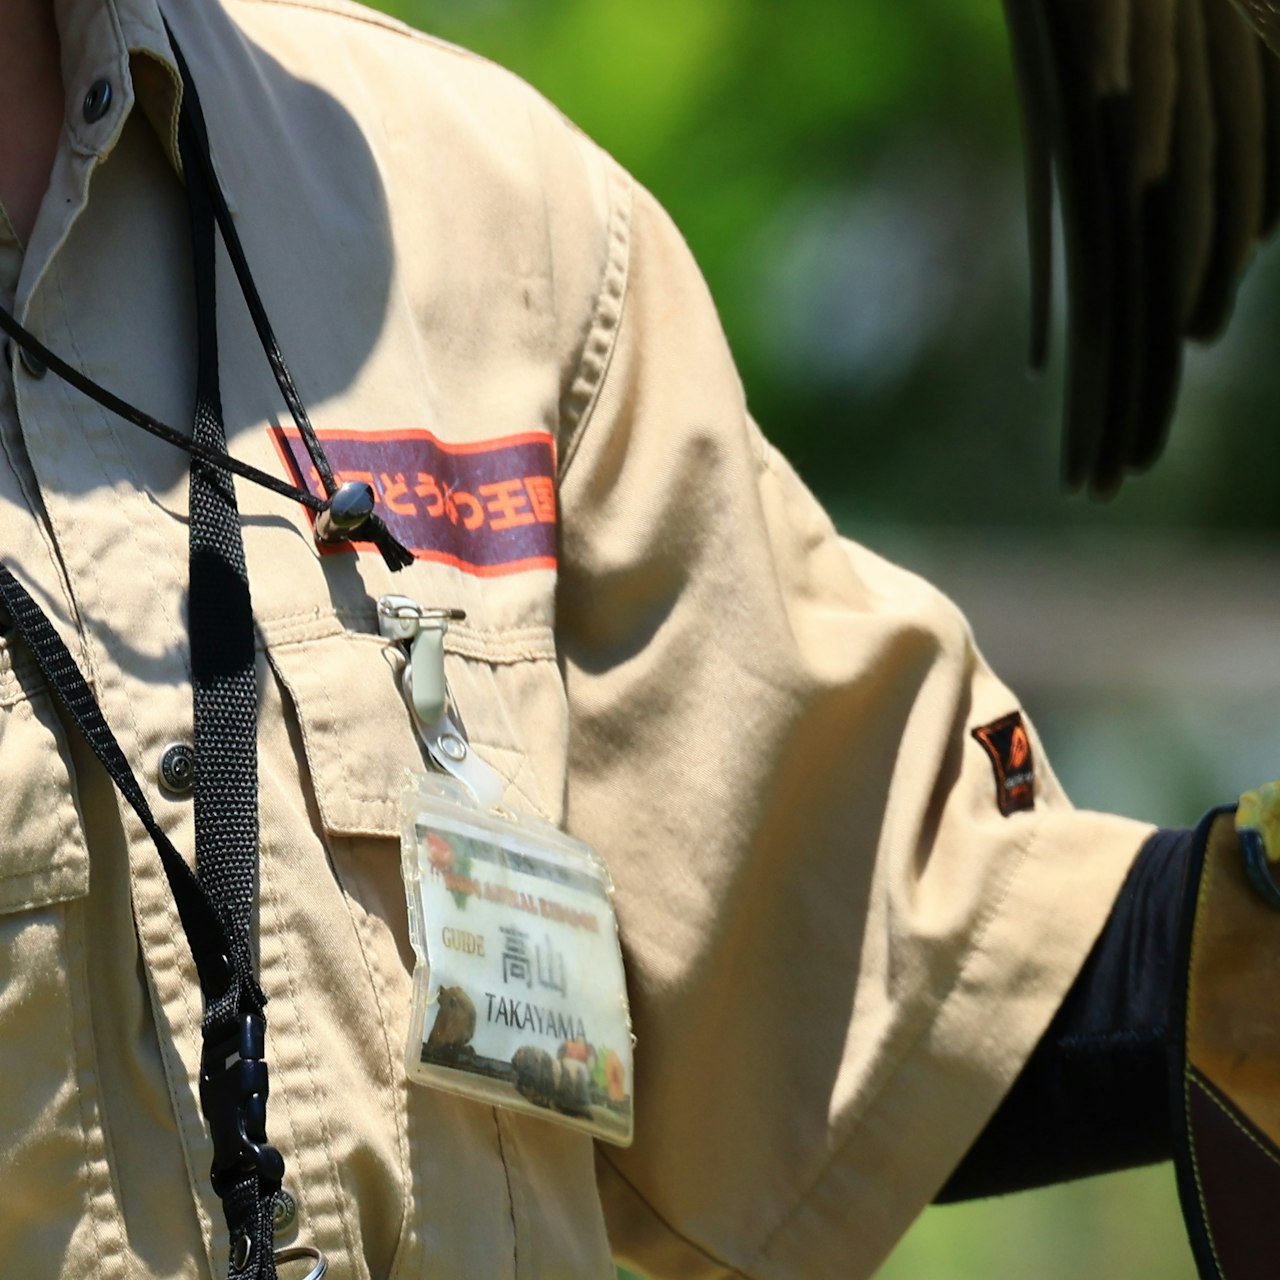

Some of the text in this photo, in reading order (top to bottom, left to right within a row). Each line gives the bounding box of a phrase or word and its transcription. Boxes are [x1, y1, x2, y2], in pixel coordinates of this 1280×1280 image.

[441, 925, 486, 958] GUIDE
[499, 924, 568, 1000] 高山
[484, 992, 587, 1041] TAKAYAMA
